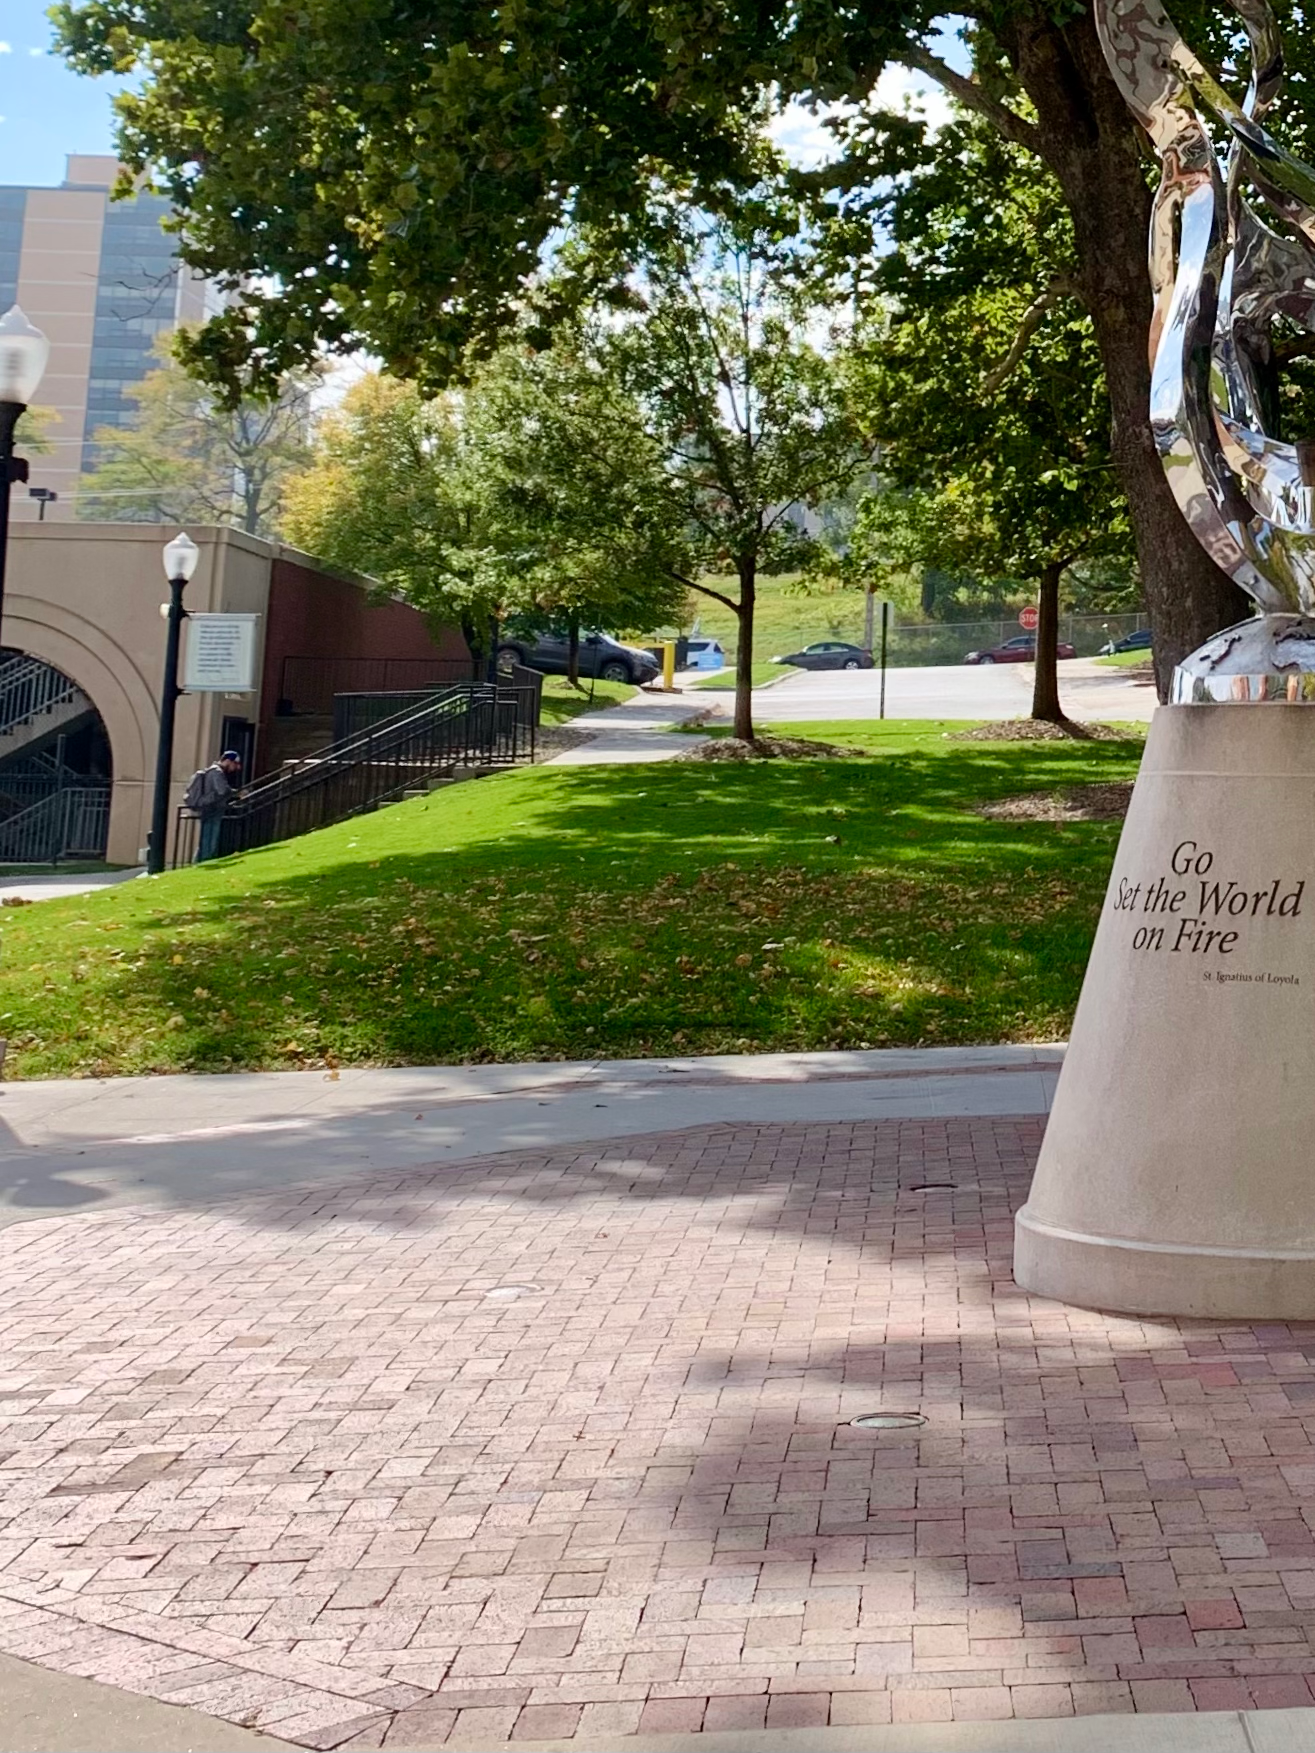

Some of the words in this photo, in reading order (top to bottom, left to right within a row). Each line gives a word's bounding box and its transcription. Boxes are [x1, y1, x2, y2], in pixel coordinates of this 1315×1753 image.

[1171, 840, 1214, 876] Go
[1114, 877, 1142, 913] Set
[1143, 876, 1187, 913] the
[1198, 879, 1306, 918] World
[1132, 926, 1165, 951] on
[1171, 918, 1240, 954] Fire
[1216, 971, 1253, 984] Ignatius
[1254, 971, 1267, 982] of
[1267, 973, 1300, 986] Loyola
